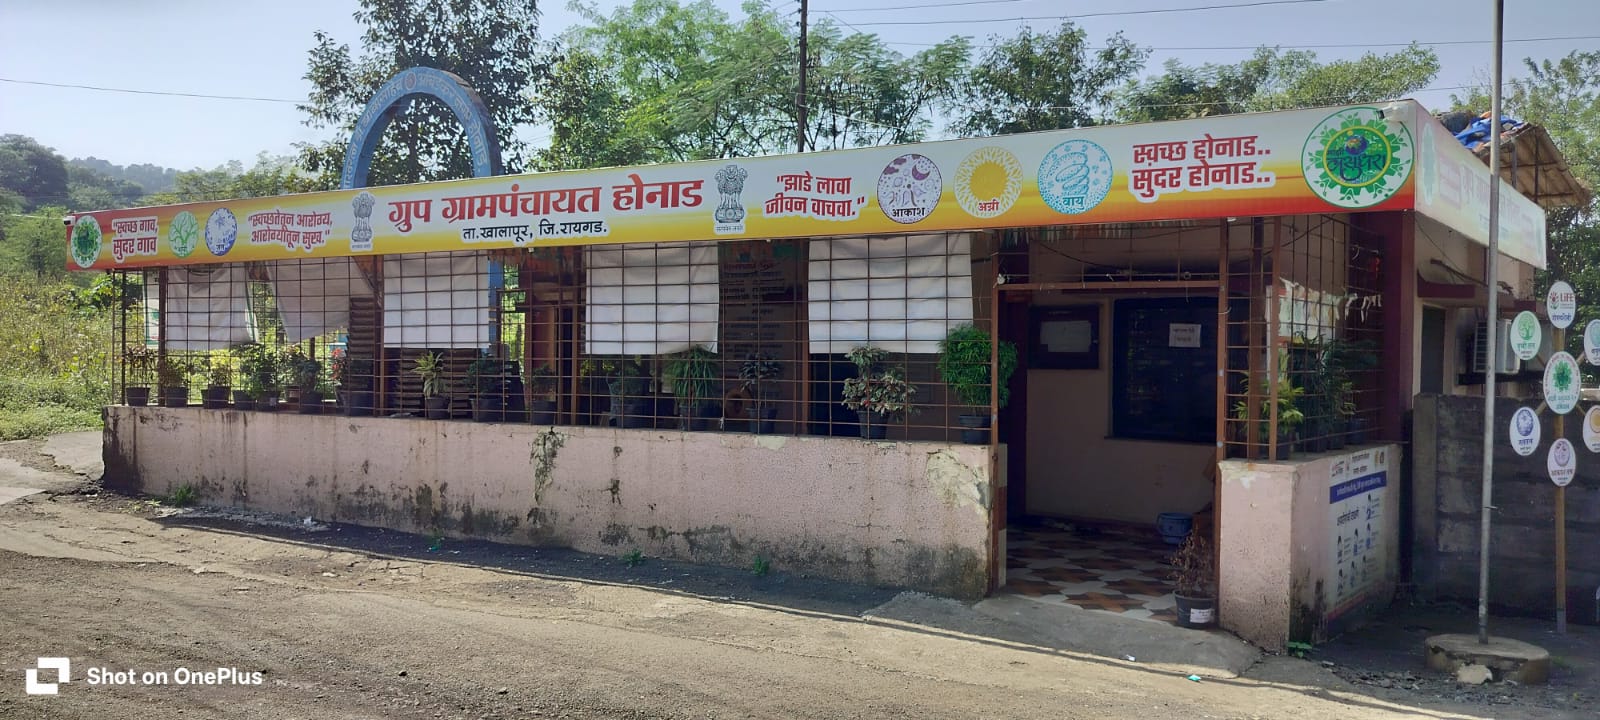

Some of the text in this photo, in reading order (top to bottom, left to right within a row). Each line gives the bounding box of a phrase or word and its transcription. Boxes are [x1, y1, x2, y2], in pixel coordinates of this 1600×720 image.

[1132, 134, 1270, 164] स्वच्छ होनाड..
[776, 171, 852, 194] "झाडे लावा
[1132, 160, 1270, 198] सुंदर होनाड..
[388, 173, 704, 232] ग्रुप ग्रामपंचायत होनाड
[766, 193, 808, 214] जीवन
[892, 207, 925, 218] आकाश
[462, 218, 607, 242] ता.खालापूर, जि.रायगड.
[113, 235, 157, 260] सुंदर गाव
